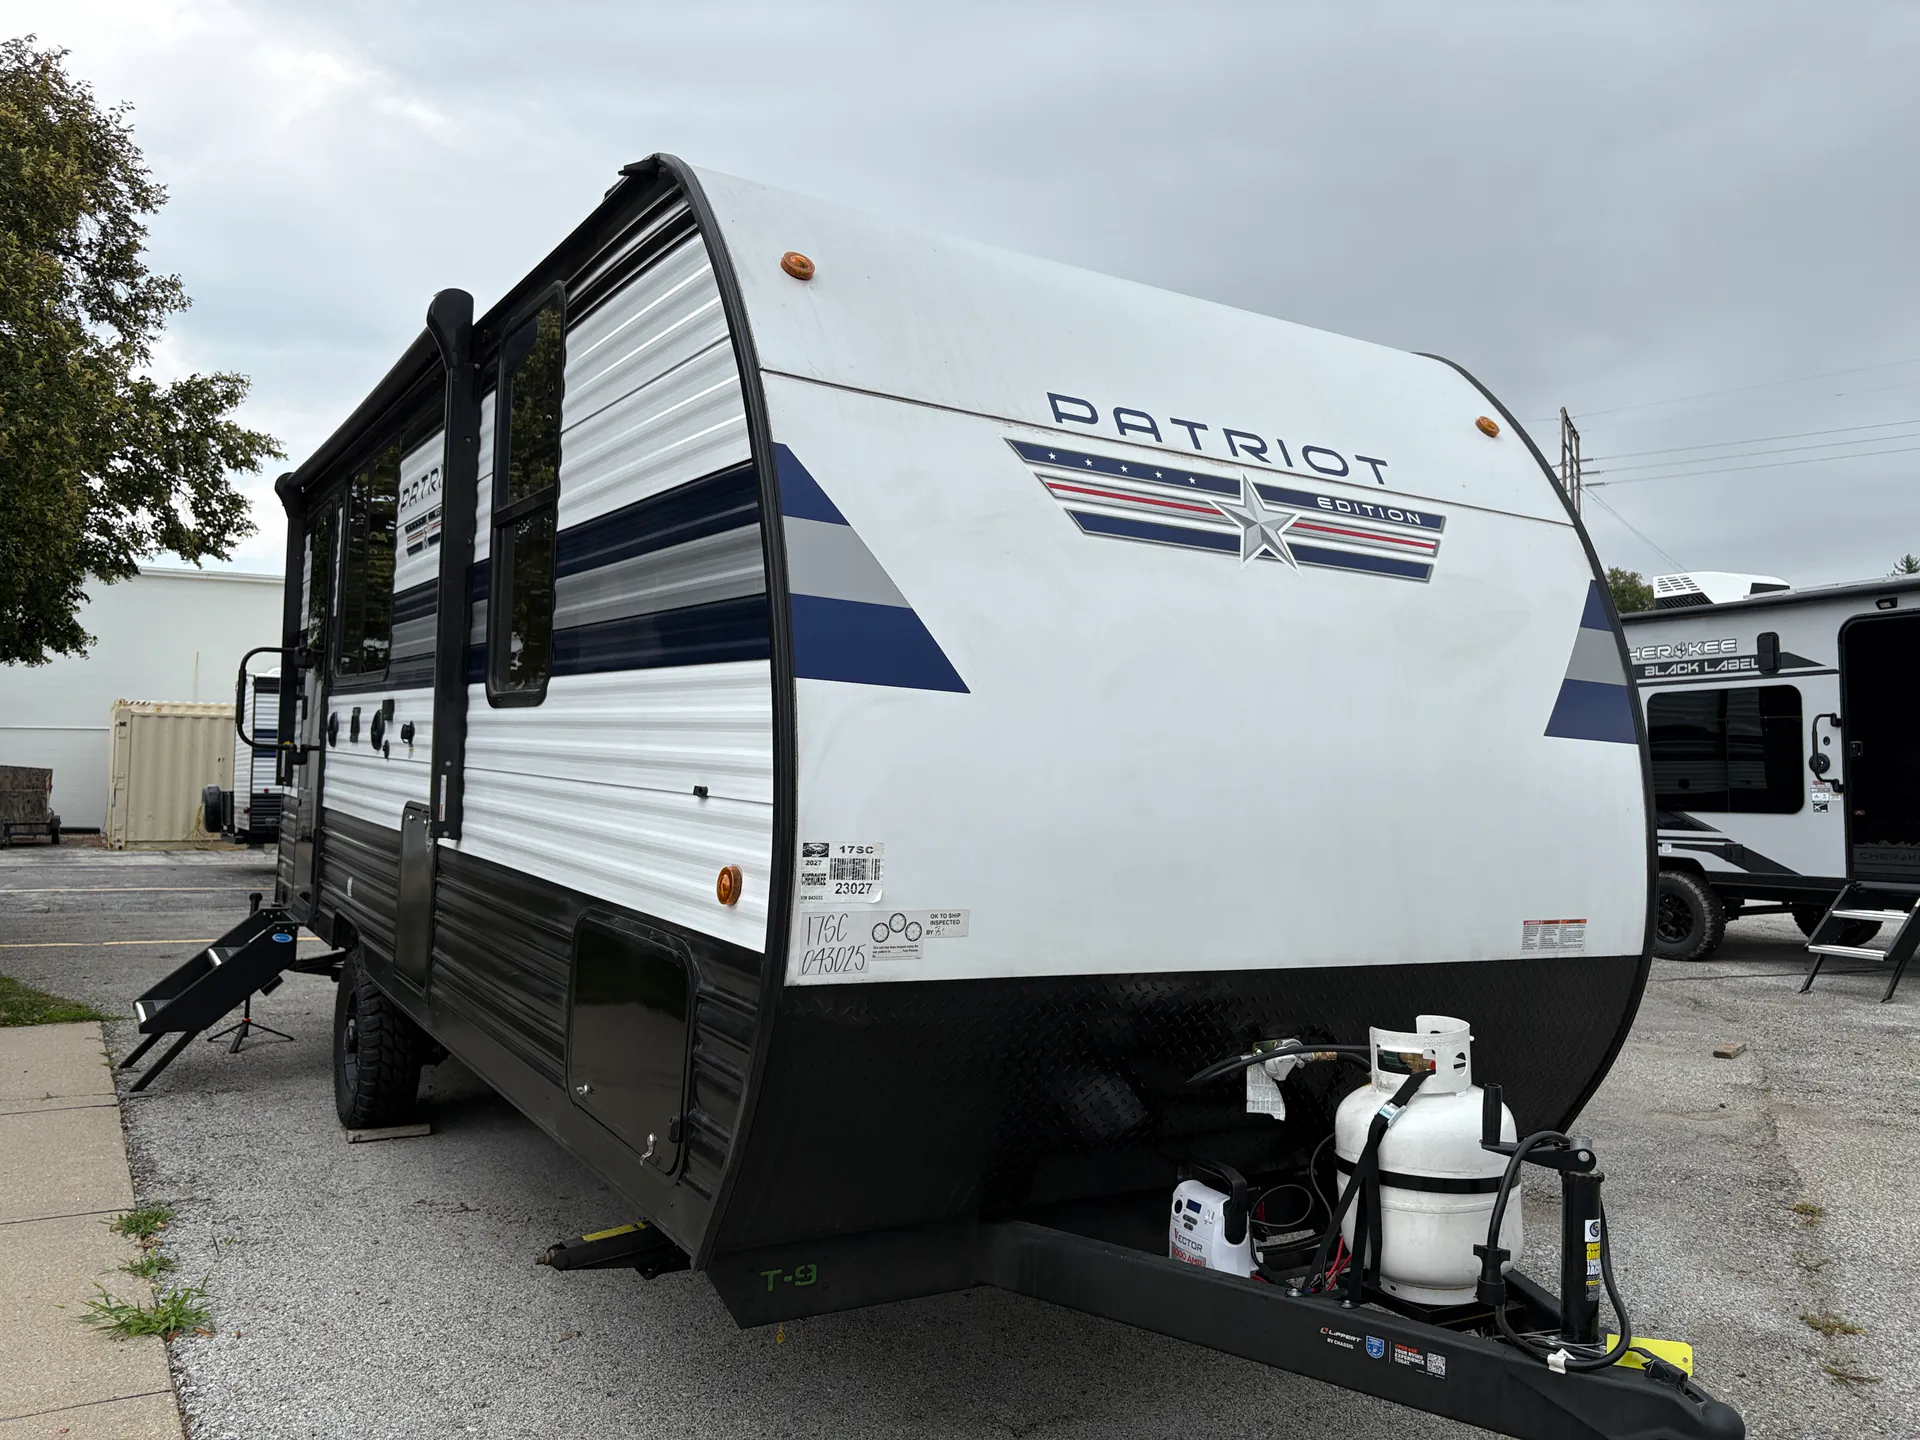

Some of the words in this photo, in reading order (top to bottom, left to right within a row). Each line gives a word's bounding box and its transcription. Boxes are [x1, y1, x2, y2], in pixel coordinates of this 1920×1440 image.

[1046, 391, 1389, 486] PATRIOT
[1317, 496, 1422, 525] EDITION
[1644, 662, 1700, 677] BLACK
[1704, 657, 1760, 673] LABEL
[839, 845, 875, 855] 17SC
[834, 882, 874, 895] 23027
[806, 912, 849, 947] 17SC
[1174, 1227, 1203, 1253] VECTOR
[760, 1263, 818, 1292] T-9
[1328, 1329, 1364, 1343] LIPPERT
[1334, 1339, 1354, 1350] CHASSIS
[1394, 1348, 1408, 1356] YOUR
[1394, 1352, 1425, 1366] EXPERIENCE
